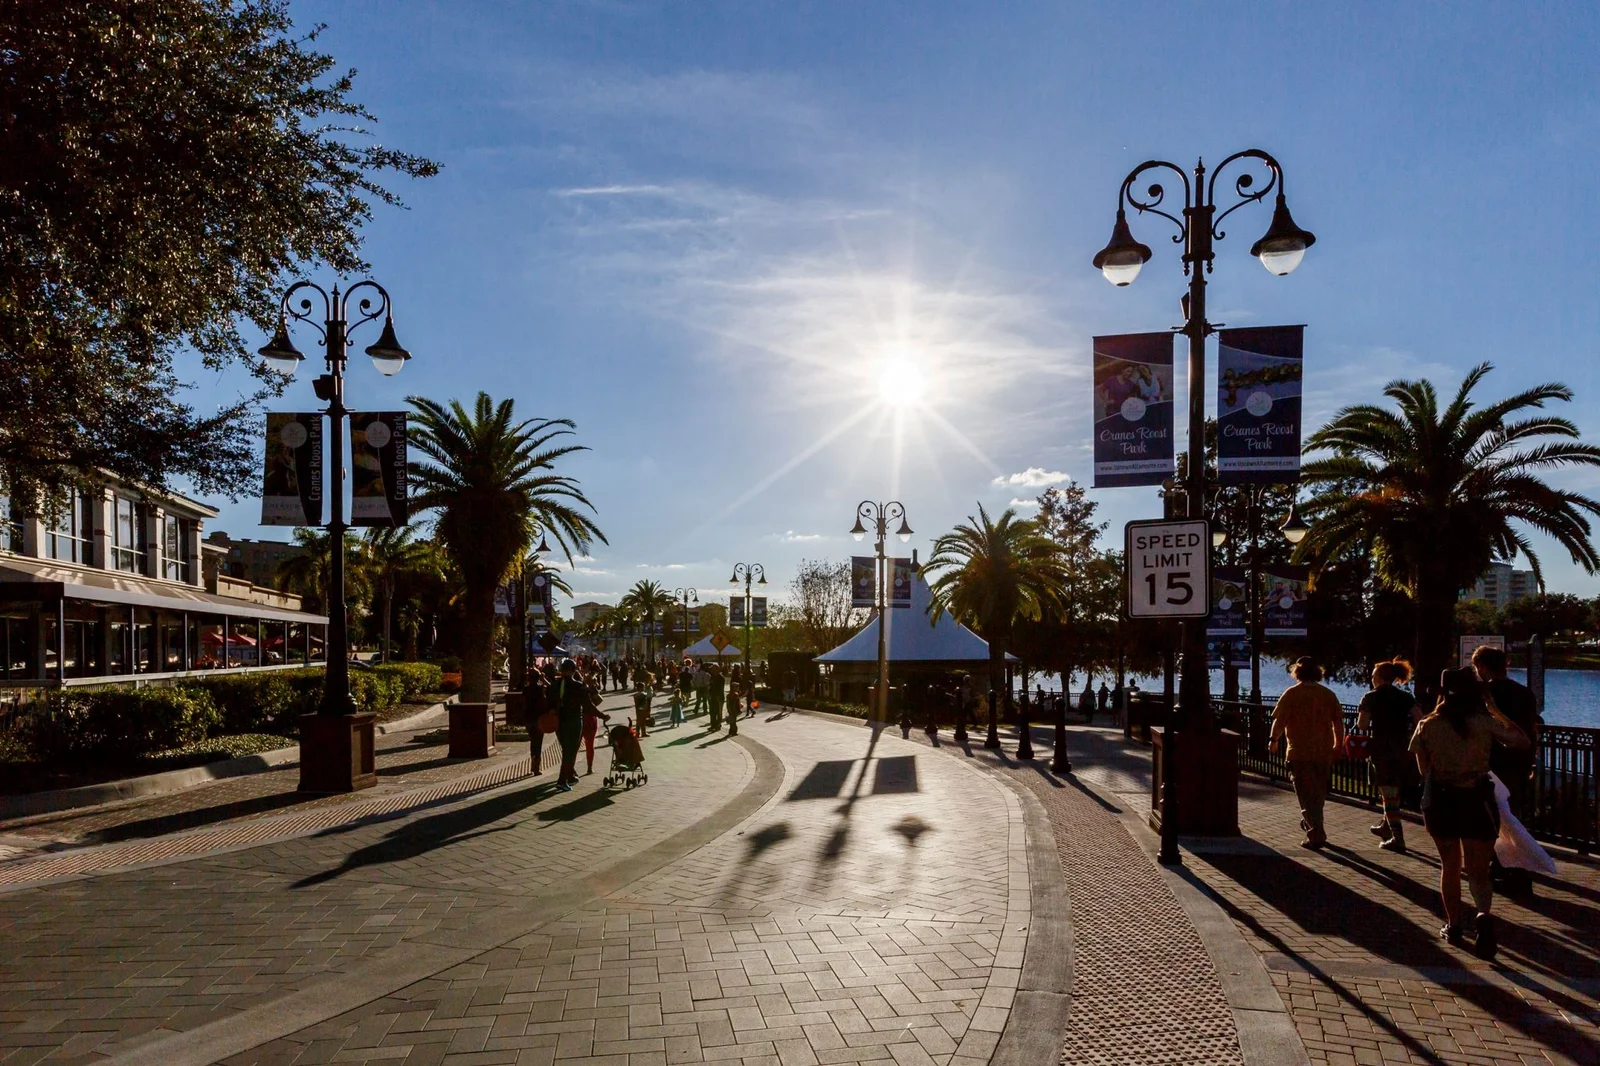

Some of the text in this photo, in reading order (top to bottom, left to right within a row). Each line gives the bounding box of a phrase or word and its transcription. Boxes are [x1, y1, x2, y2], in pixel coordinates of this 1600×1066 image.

[1100, 427, 1168, 442] Cranes Roost
[1223, 422, 1295, 437] Cranes Roost
[1119, 441, 1148, 455] Park
[1244, 436, 1273, 451] Park
[308, 415, 321, 501] Cranes Roost Park
[393, 414, 406, 501] Cranes Roost Park
[1136, 533, 1200, 550] SPEED
[1143, 552, 1192, 568] LIMIT
[1145, 571, 1194, 606] 15
